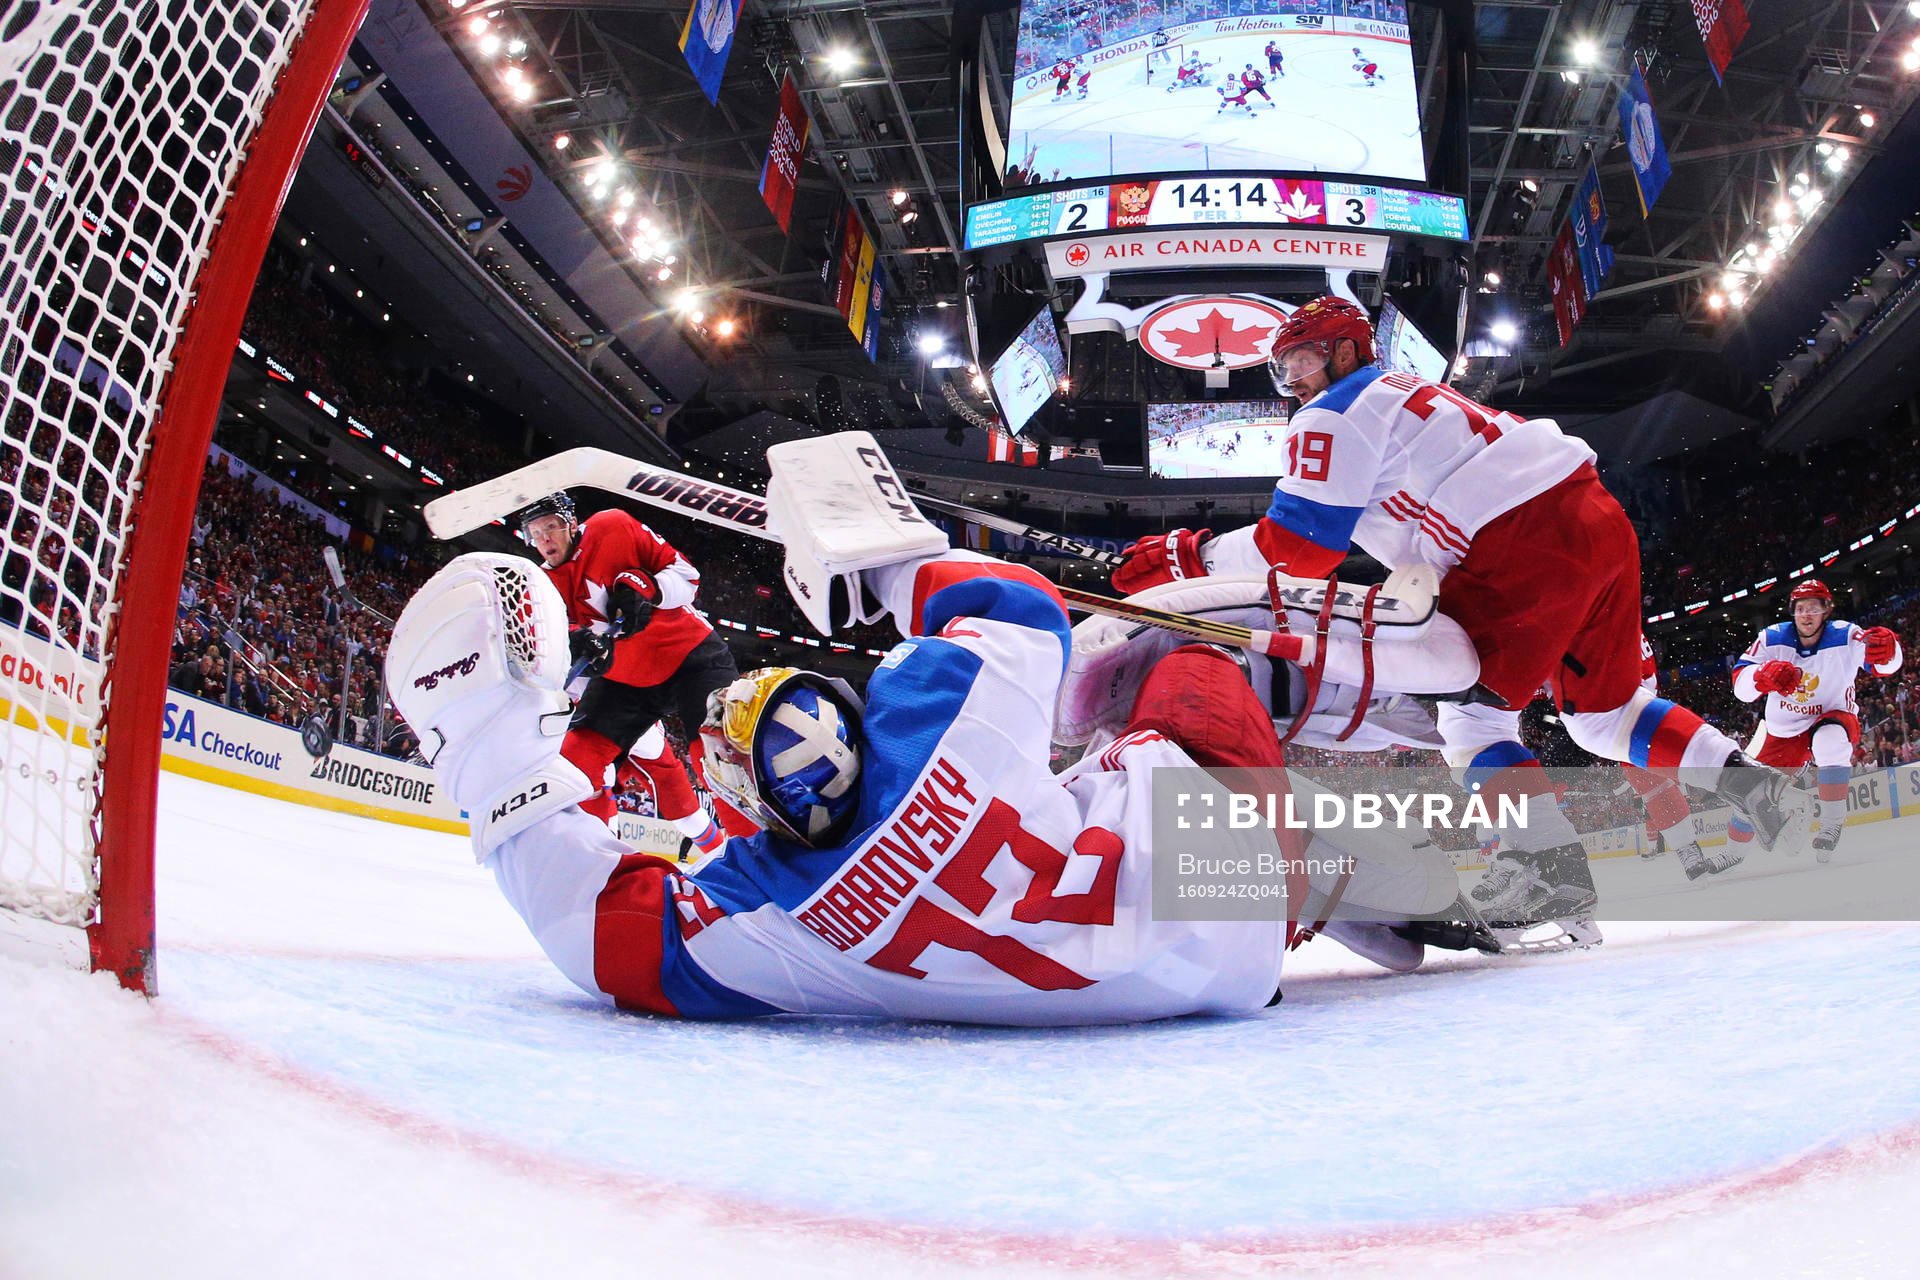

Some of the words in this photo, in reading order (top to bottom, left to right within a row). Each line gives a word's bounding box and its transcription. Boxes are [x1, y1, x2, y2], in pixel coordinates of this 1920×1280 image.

[1214, 20, 1234, 33] Tim
[1295, 15, 1324, 25] SN
[1093, 39, 1150, 65] HONDA
[776, 120, 789, 145] CUP
[780, 111, 801, 153] WORLD
[769, 143, 784, 175] 2016
[773, 131, 798, 180] HOCKEY
[1056, 190, 1088, 203] SHOTS
[1092, 188, 1104, 196] 16
[1172, 182, 1268, 208] 14:14
[1328, 183, 1361, 195] SHOTS
[1364, 187, 1377, 196] 38
[1067, 203, 1088, 232] 2
[1193, 210, 1227, 221] PER
[1345, 198, 1366, 226] 3
[1385, 222, 1422, 233] COUTURE
[1104, 243, 1145, 259] AIR
[1157, 239, 1262, 255] CANADA
[1273, 239, 1367, 257] CENTRE
[857, 447, 924, 523] CCM
[1022, 527, 1131, 567] EASTO
[1780, 700, 1823, 716] РОССИЯ
[163, 703, 196, 748] SA
[201, 731, 282, 771] Checkout
[310, 755, 435, 805] BRIDGESTONE
[491, 782, 549, 823] CCM
[623, 822, 645, 841] CUP
[653, 829, 685, 847] HOCK
[797, 758, 977, 951] BOBROVSKY
[866, 797, 1124, 992] 72
